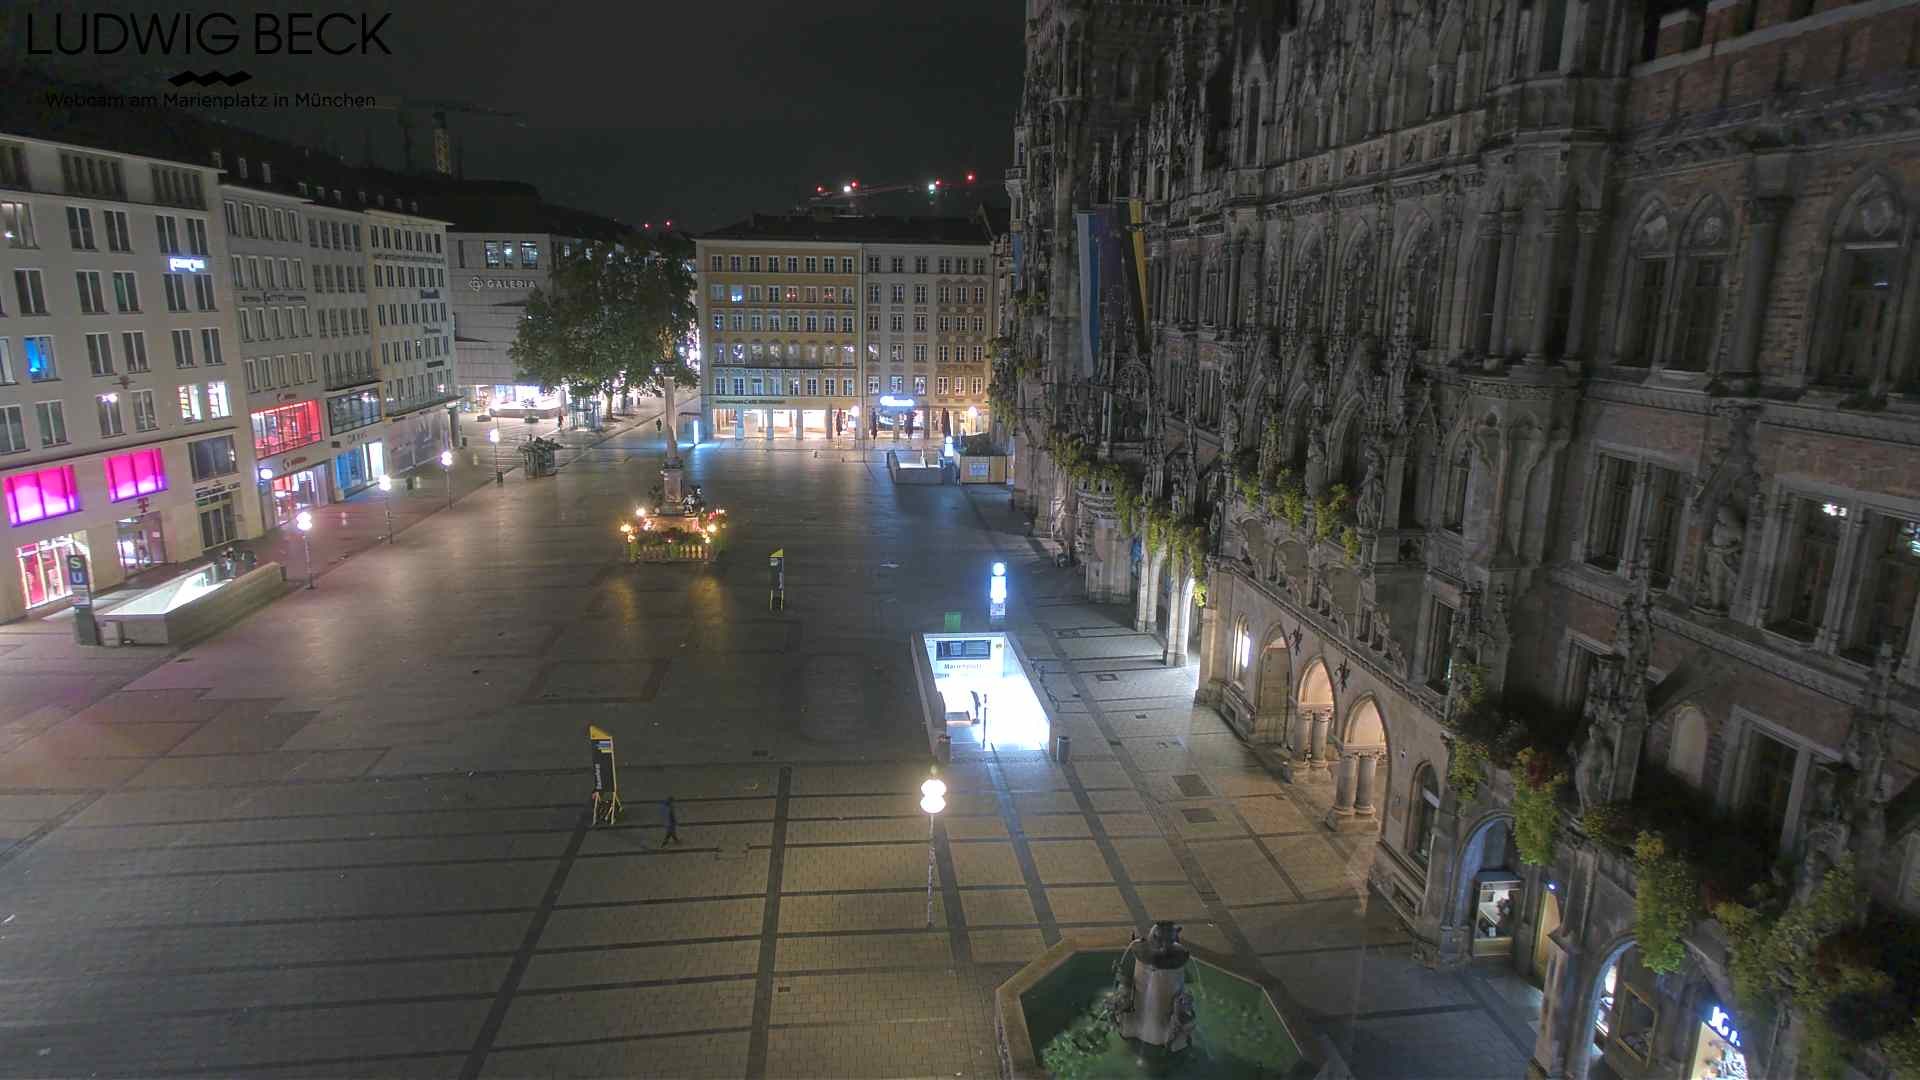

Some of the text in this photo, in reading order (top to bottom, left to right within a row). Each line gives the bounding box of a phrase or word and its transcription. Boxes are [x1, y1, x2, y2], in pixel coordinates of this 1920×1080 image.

[487, 280, 536, 288] GALERIA
[70, 556, 81, 569] S
[72, 571, 83, 583] U
